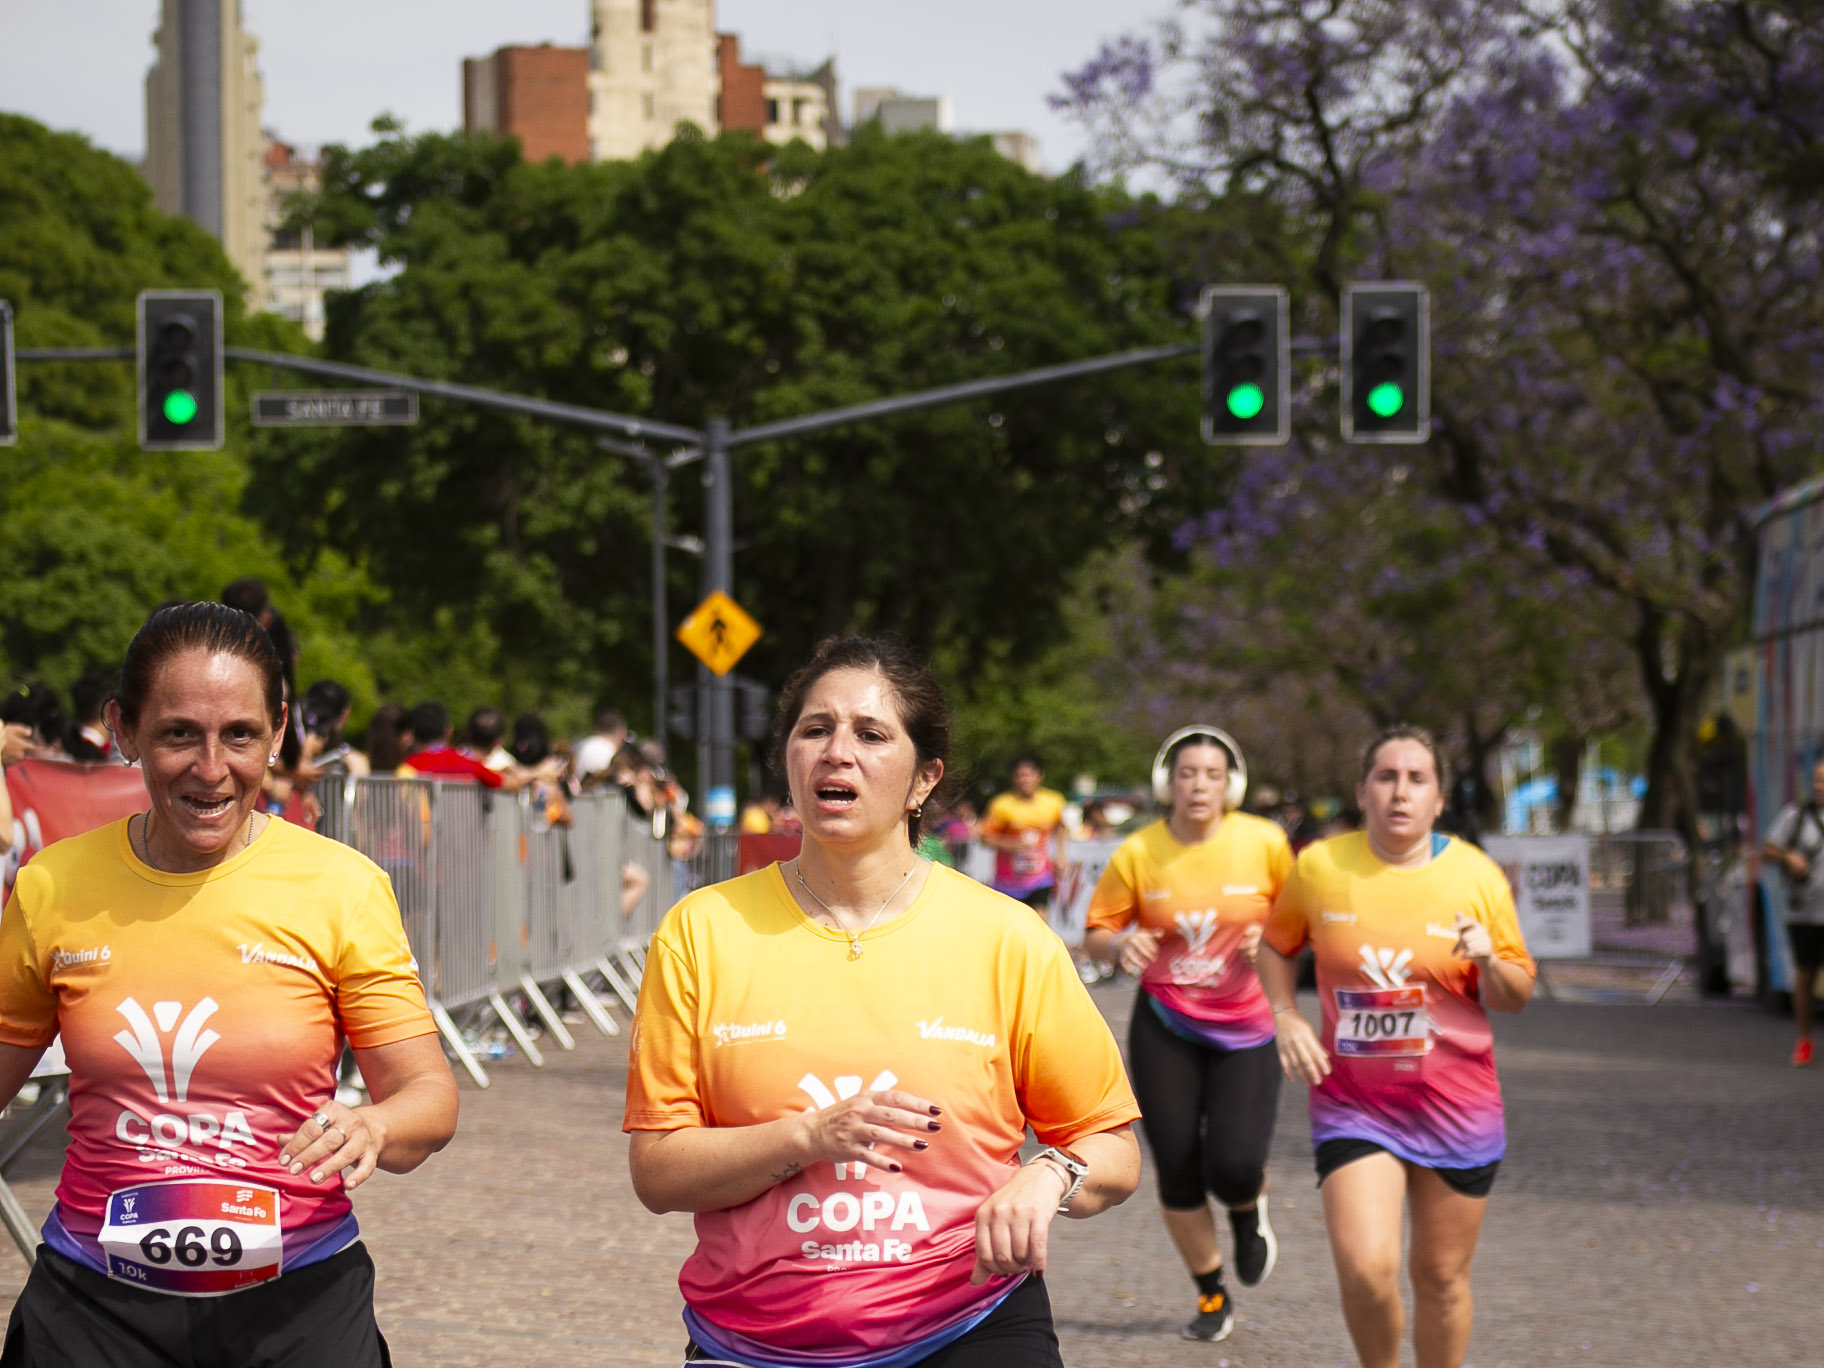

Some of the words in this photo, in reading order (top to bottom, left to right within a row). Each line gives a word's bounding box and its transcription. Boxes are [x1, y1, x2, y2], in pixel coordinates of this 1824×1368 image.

[1352, 1011, 1415, 1037] 1007
[116, 1110, 257, 1149] COPA
[221, 1202, 252, 1216] Santa
[253, 1207, 267, 1218] Fe
[786, 1191, 930, 1233] COPA
[139, 1226, 243, 1267] 669
[801, 1240, 880, 1262] Santa
[883, 1238, 912, 1262] Fe
[118, 1261, 148, 1281] 10k
